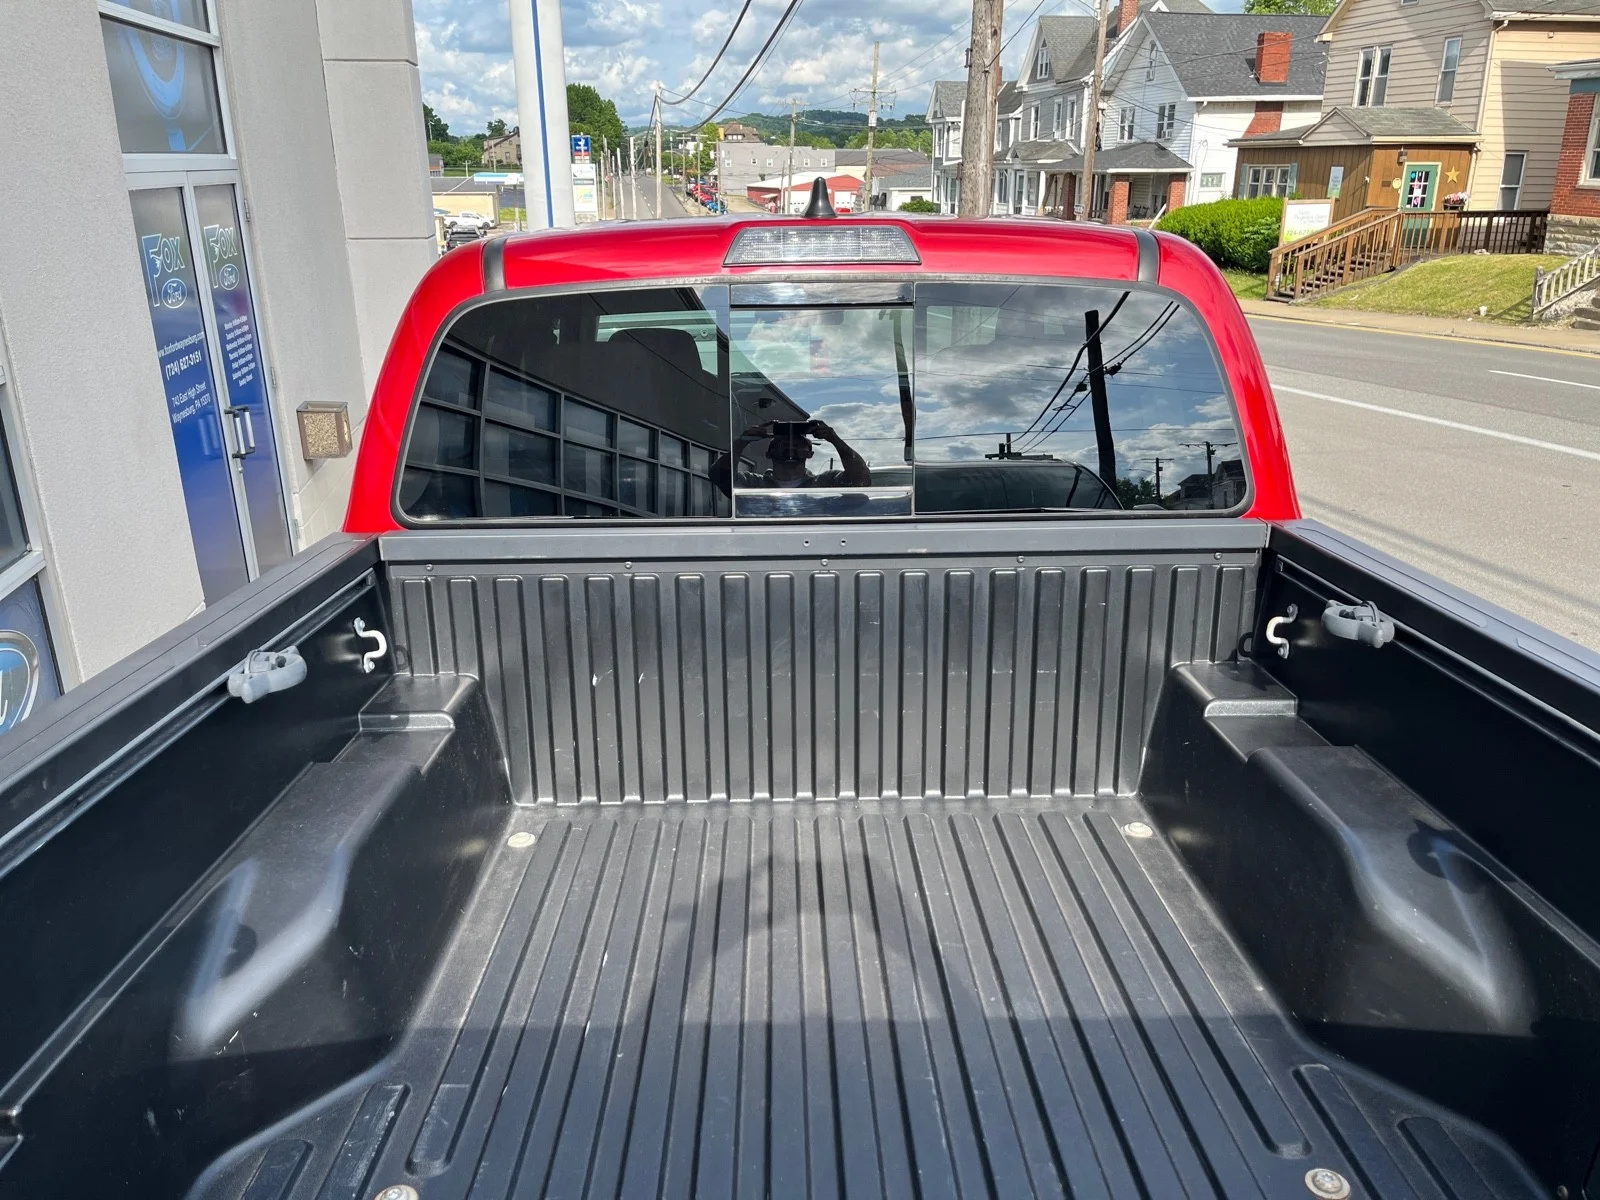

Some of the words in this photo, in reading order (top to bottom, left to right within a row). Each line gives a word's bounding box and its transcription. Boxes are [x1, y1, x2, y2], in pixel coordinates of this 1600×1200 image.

[204, 224, 238, 288] FOX
[142, 233, 185, 307] FOX
[167, 282, 182, 304] Ford
[165, 360, 181, 380] (724)
[179, 350, 202, 371] 627-3151
[179, 391, 188, 404] East
[187, 386, 196, 399] High
[195, 381, 206, 394] Street
[194, 398, 201, 410] PA
